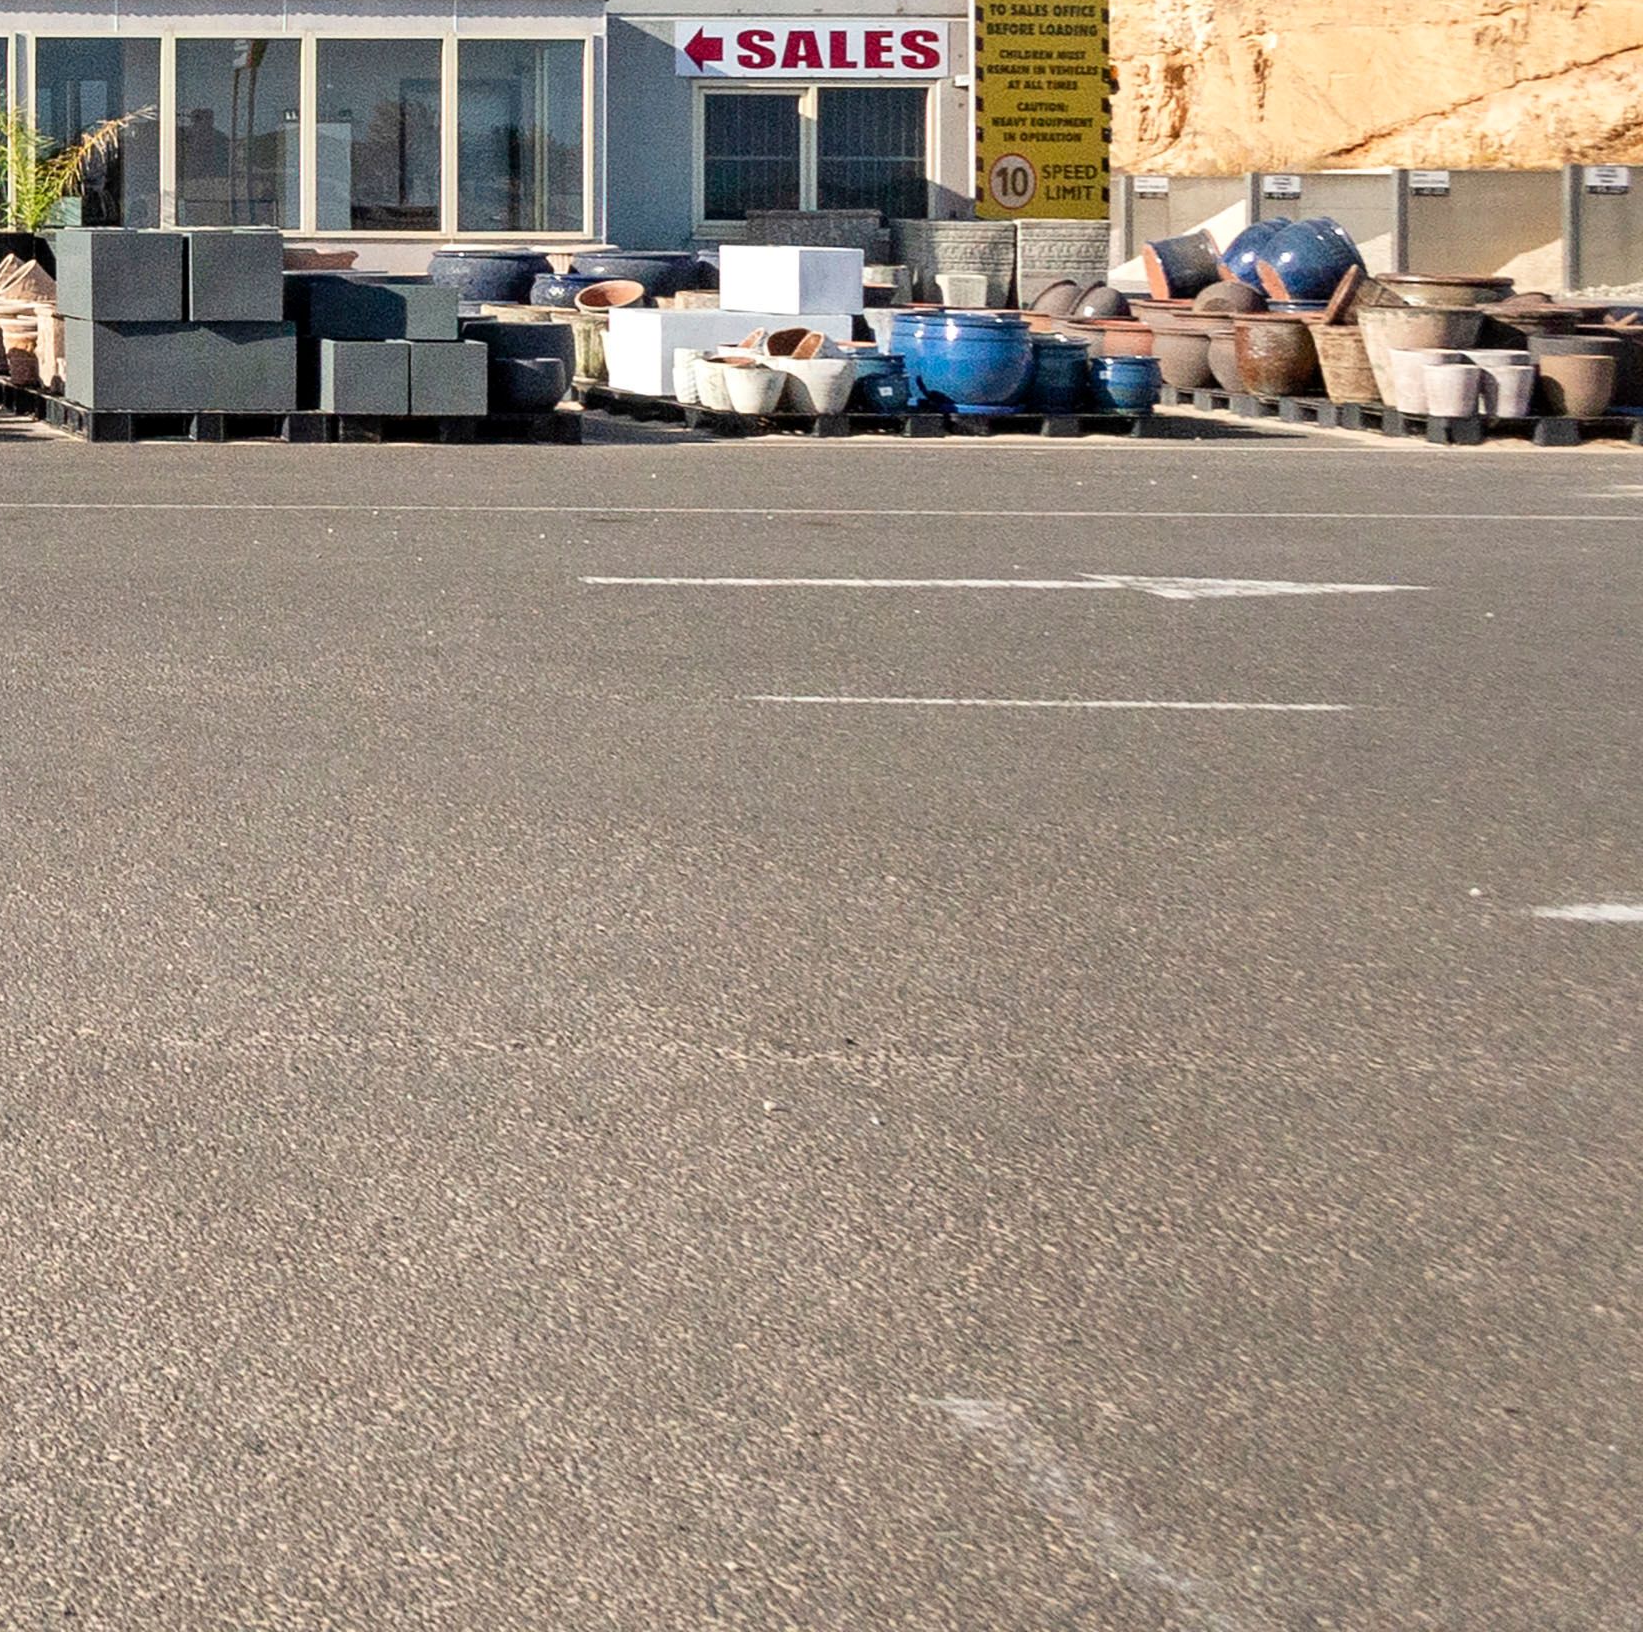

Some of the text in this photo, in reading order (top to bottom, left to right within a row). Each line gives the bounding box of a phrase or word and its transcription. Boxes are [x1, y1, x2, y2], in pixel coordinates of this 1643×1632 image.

[990, 5, 1096, 17] TO SALES OFFICE
[987, 24, 1097, 36] BEFORE LOADING
[737, 30, 941, 69] SALES
[999, 50, 1086, 60] CHILDREN MUST
[987, 65, 1098, 75] REMAIN IN VEHICLES
[1008, 81, 1077, 90] AT ALL TIMES
[1017, 102, 1069, 112] CAUTION:
[992, 118, 1093, 128] HEAVY EQUIPMENT
[1003, 133, 1083, 142] IN OPERATION
[1042, 165, 1097, 179] SPEED
[996, 167, 1028, 196] 10
[1046, 186, 1094, 200] LIMIT
